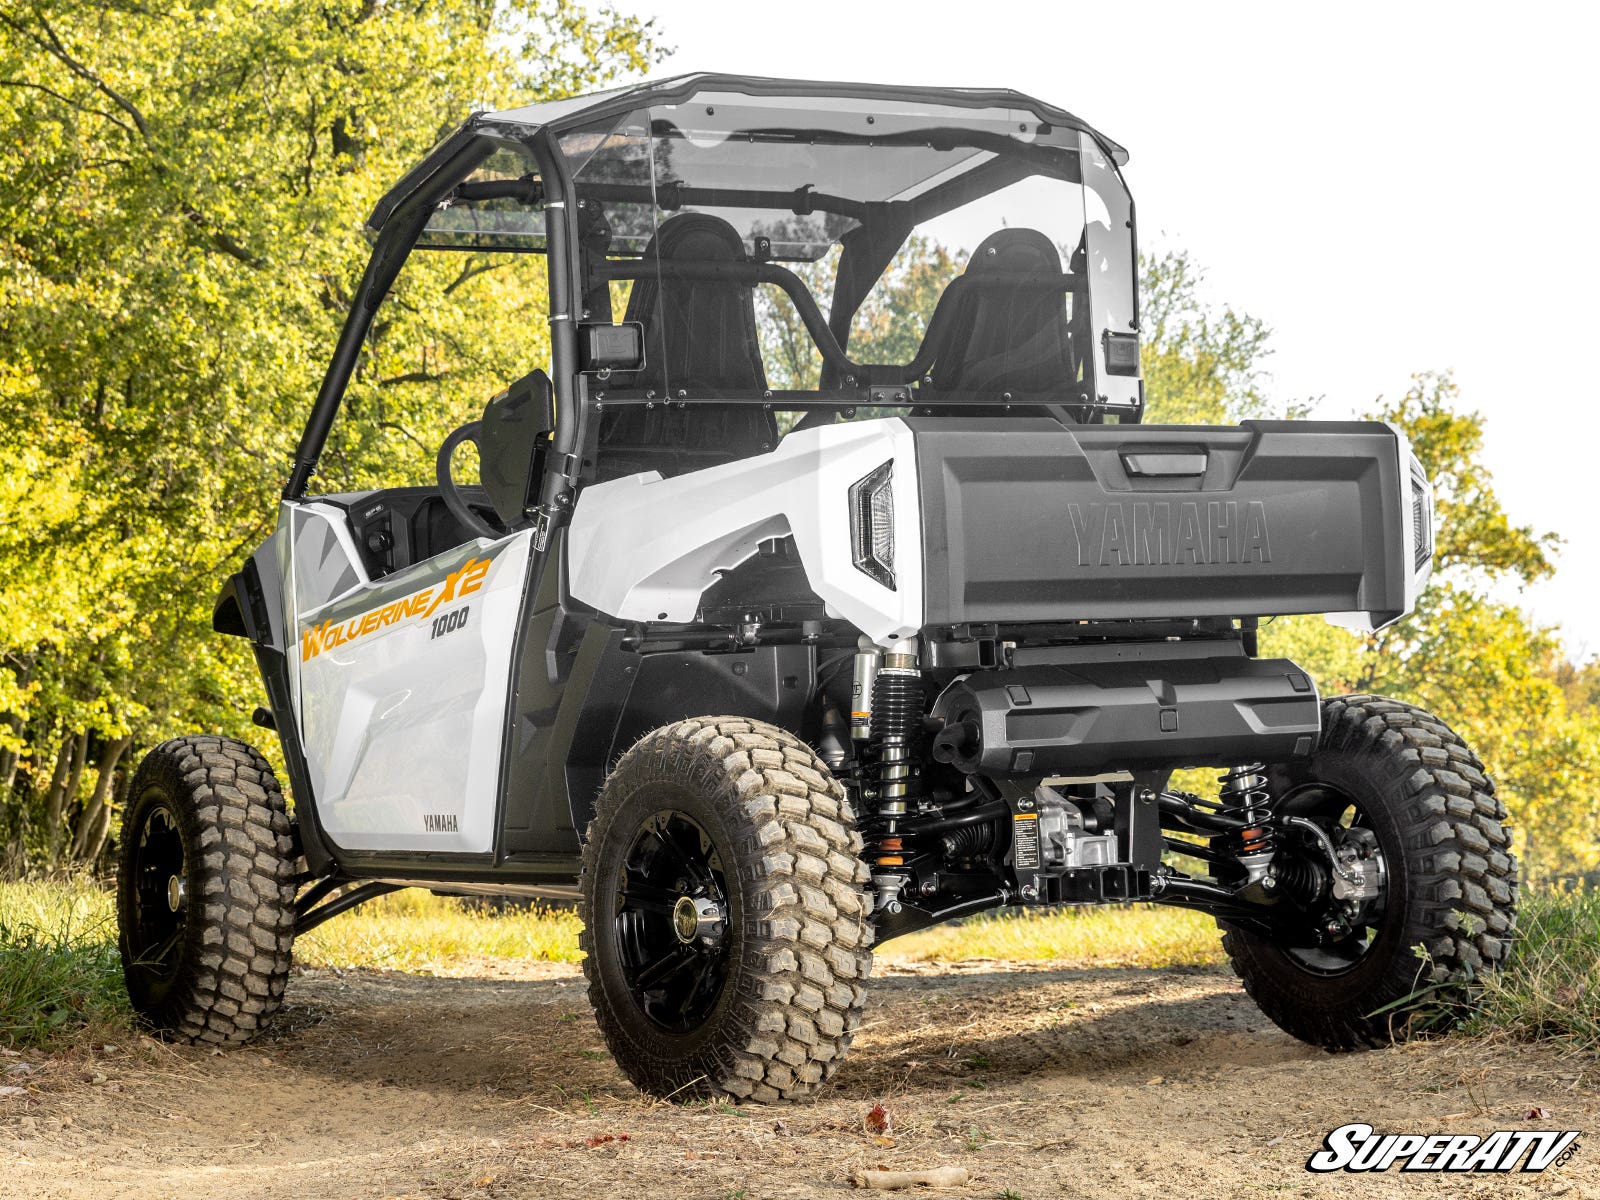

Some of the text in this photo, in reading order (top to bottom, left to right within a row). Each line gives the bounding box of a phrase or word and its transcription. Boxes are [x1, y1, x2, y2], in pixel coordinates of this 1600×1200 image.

[1067, 501, 1272, 566] YAMAHA
[420, 557, 492, 620] X2
[431, 605, 470, 641] 1000
[423, 814, 458, 832] YAMAHA
